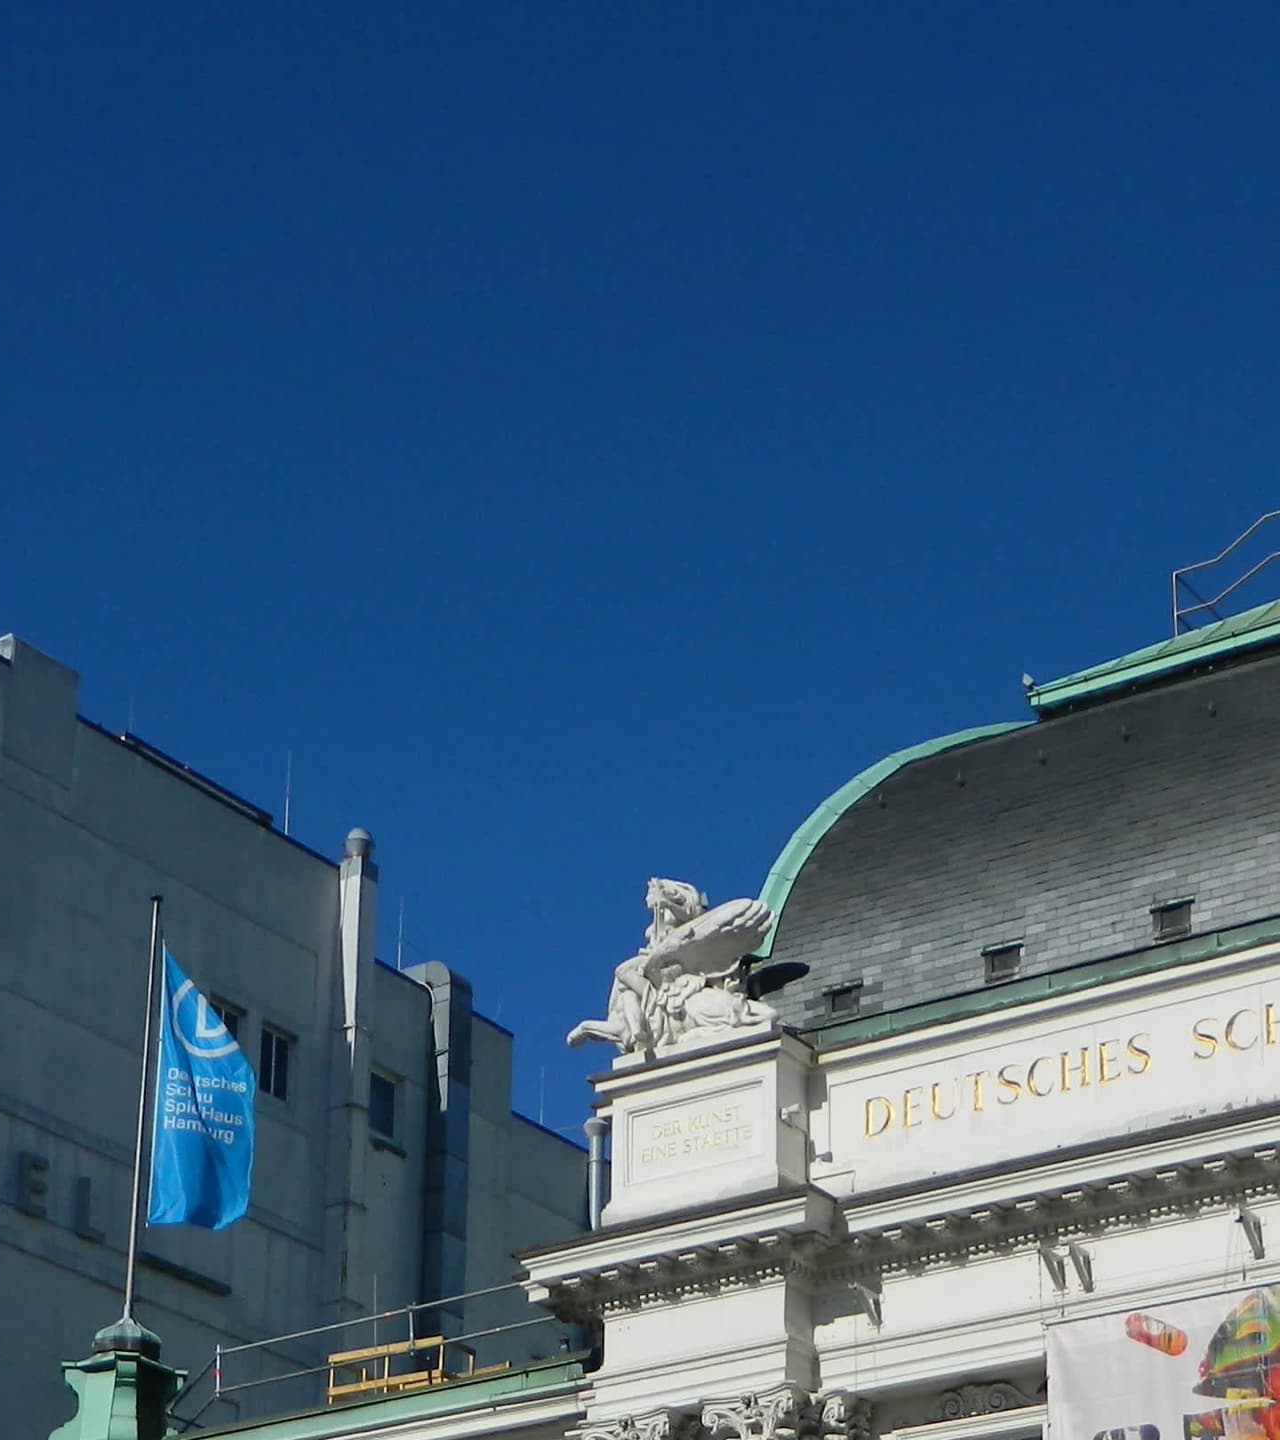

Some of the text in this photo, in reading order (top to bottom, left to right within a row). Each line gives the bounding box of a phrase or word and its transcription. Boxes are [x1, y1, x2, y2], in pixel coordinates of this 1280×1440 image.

[167, 1067, 247, 1093] Detsches
[863, 1032, 1154, 1140] DEUTSCHES
[164, 1098, 243, 1126] SpieHaus
[163, 1115, 235, 1145] Hamurg
